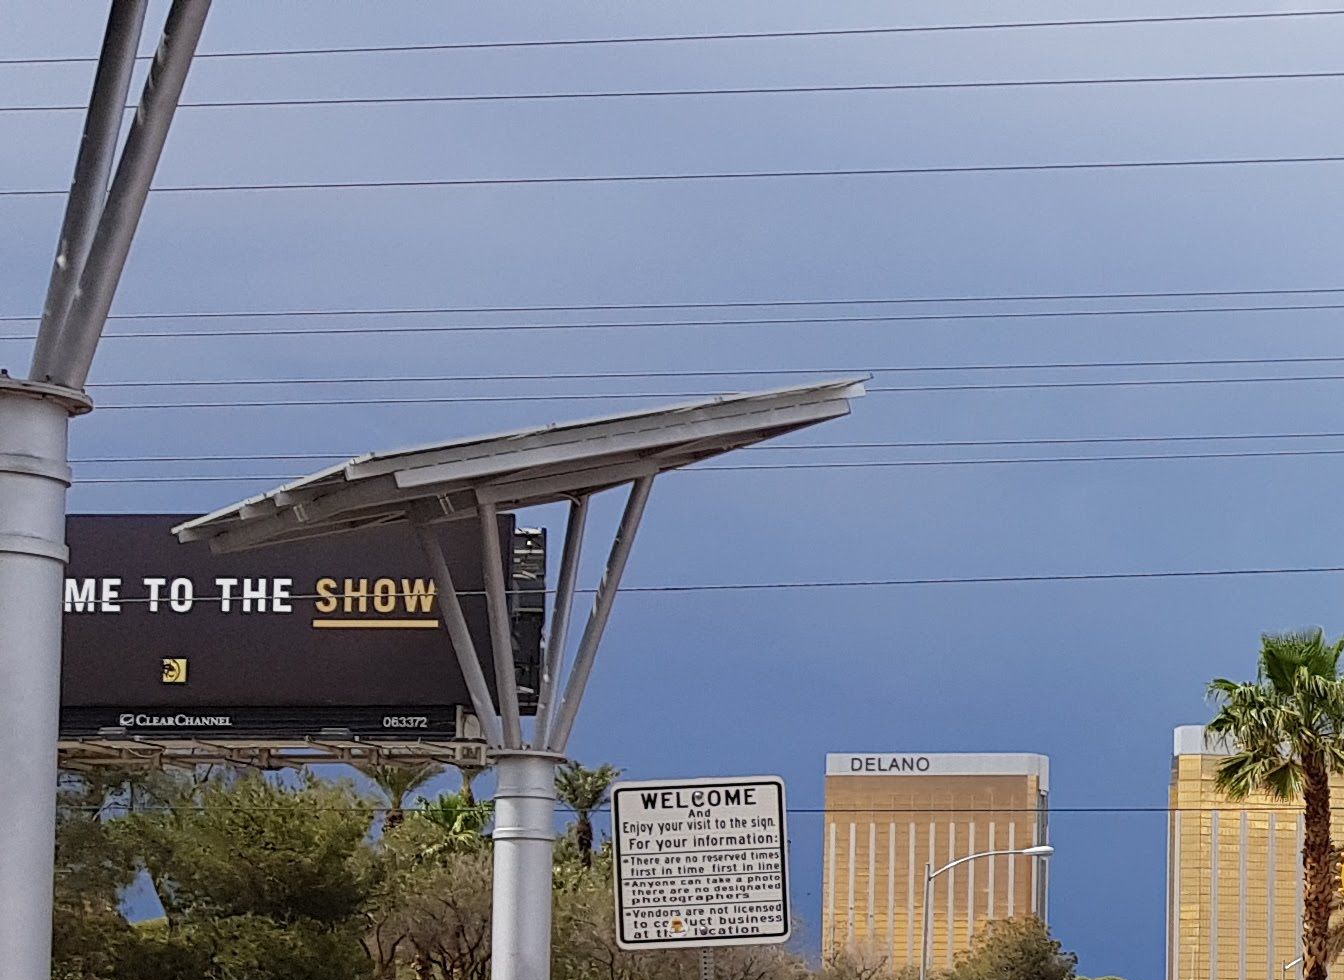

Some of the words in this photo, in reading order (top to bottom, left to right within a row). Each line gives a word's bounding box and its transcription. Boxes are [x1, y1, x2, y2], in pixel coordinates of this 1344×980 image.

[144, 578, 194, 612] TO
[216, 578, 292, 612] THE
[315, 578, 437, 614] SHOW
[383, 716, 428, 728] 063372
[851, 757, 930, 771] DELANO
[641, 788, 757, 809] WELCOME
[688, 809, 711, 818] And
[623, 821, 653, 836] Enjoy
[658, 821, 683, 835] your
[687, 819, 711, 831] visit
[715, 819, 726, 829] to
[730, 817, 747, 828] the
[629, 838, 651, 850] For
[656, 838, 687, 851] your
[694, 834, 778, 848] information:
[631, 856, 660, 866] There
[664, 856, 681, 864] are
[702, 853, 747, 863] reserved
[750, 852, 779, 860] times
[631, 867, 656, 876] first
[662, 866, 672, 875] in
[678, 865, 704, 874] time
[712, 864, 737, 873] first
[743, 863, 753, 871] in
[758, 862, 779, 870] line
[632, 880, 676, 888] Anyone
[747, 875, 780, 883] photo
[714, 883, 781, 893] designated
[631, 893, 750, 905] photographers
[633, 909, 681, 918] Vendors
[686, 908, 704, 916] are
[710, 906, 728, 915] not
[734, 904, 782, 913] licensed
[634, 920, 647, 929] to
[719, 915, 783, 925] business
[634, 930, 648, 939] at
